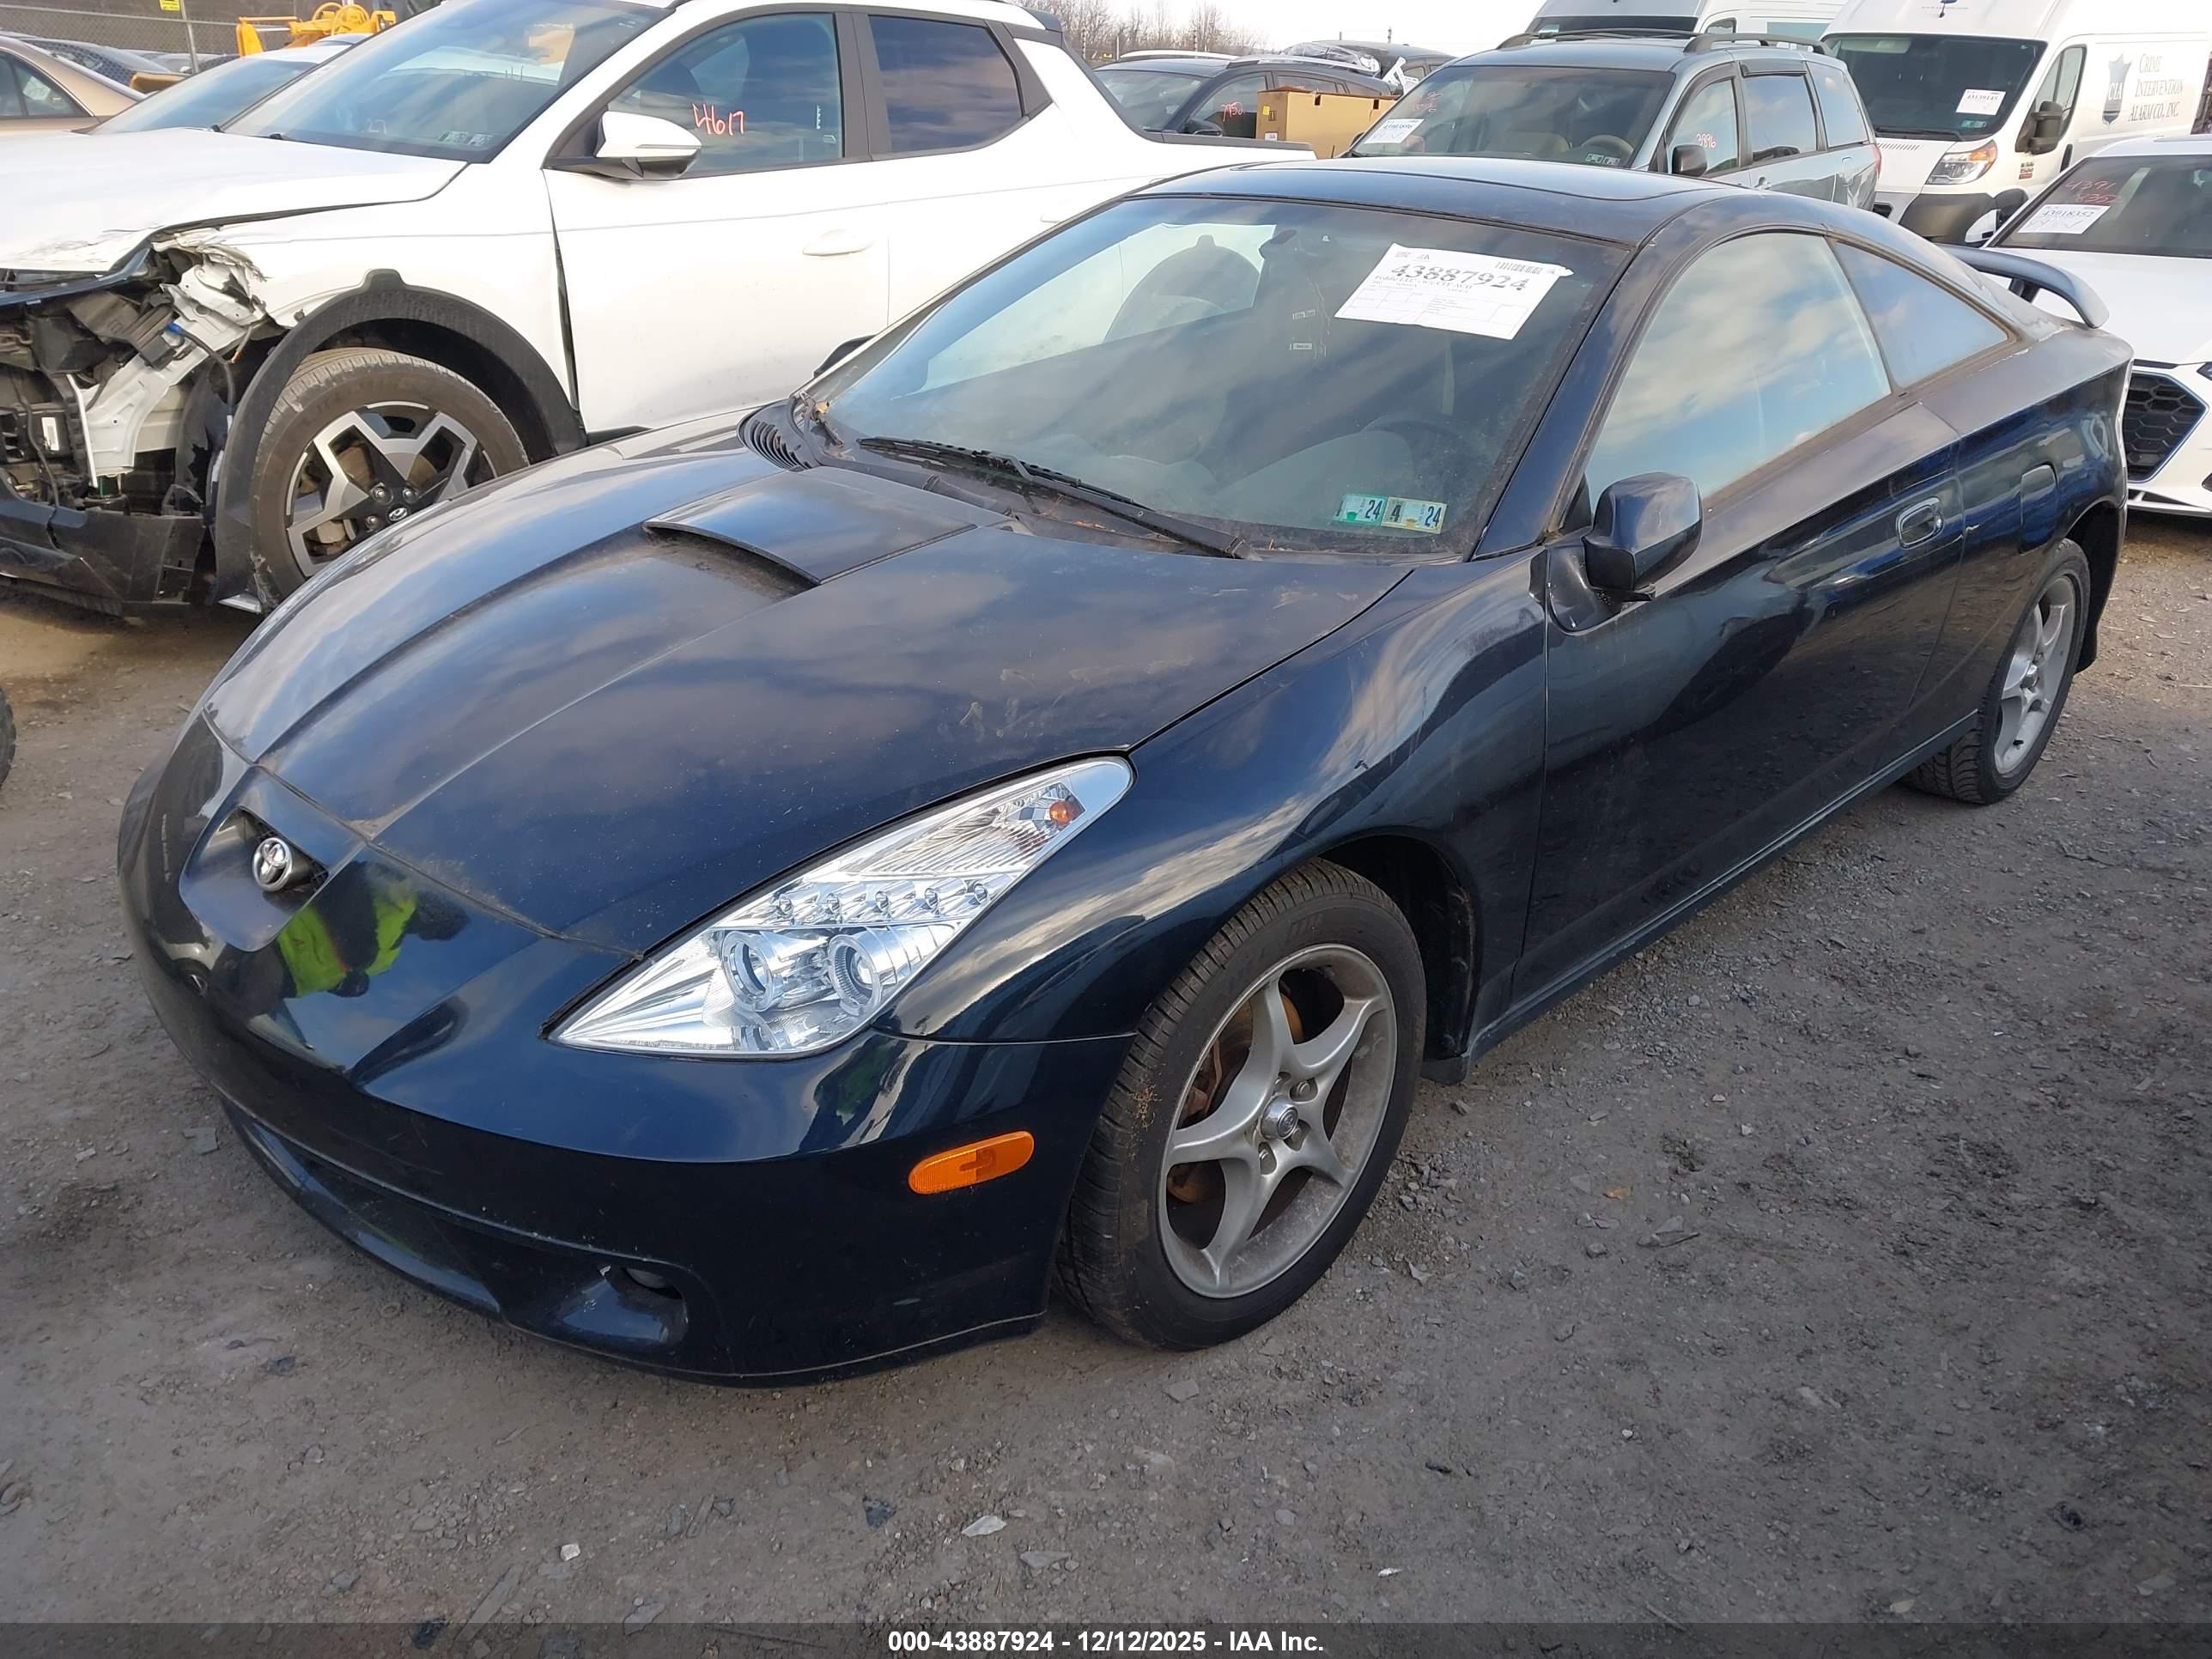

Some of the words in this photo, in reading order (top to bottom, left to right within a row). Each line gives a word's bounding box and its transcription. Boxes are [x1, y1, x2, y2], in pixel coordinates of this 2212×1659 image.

[2108, 82, 2123, 100] CIA
[692, 102, 744, 136] 4617
[1391, 264, 1530, 291] 43887924
[1365, 500, 1382, 520] 24
[1425, 506, 1442, 527] 24
